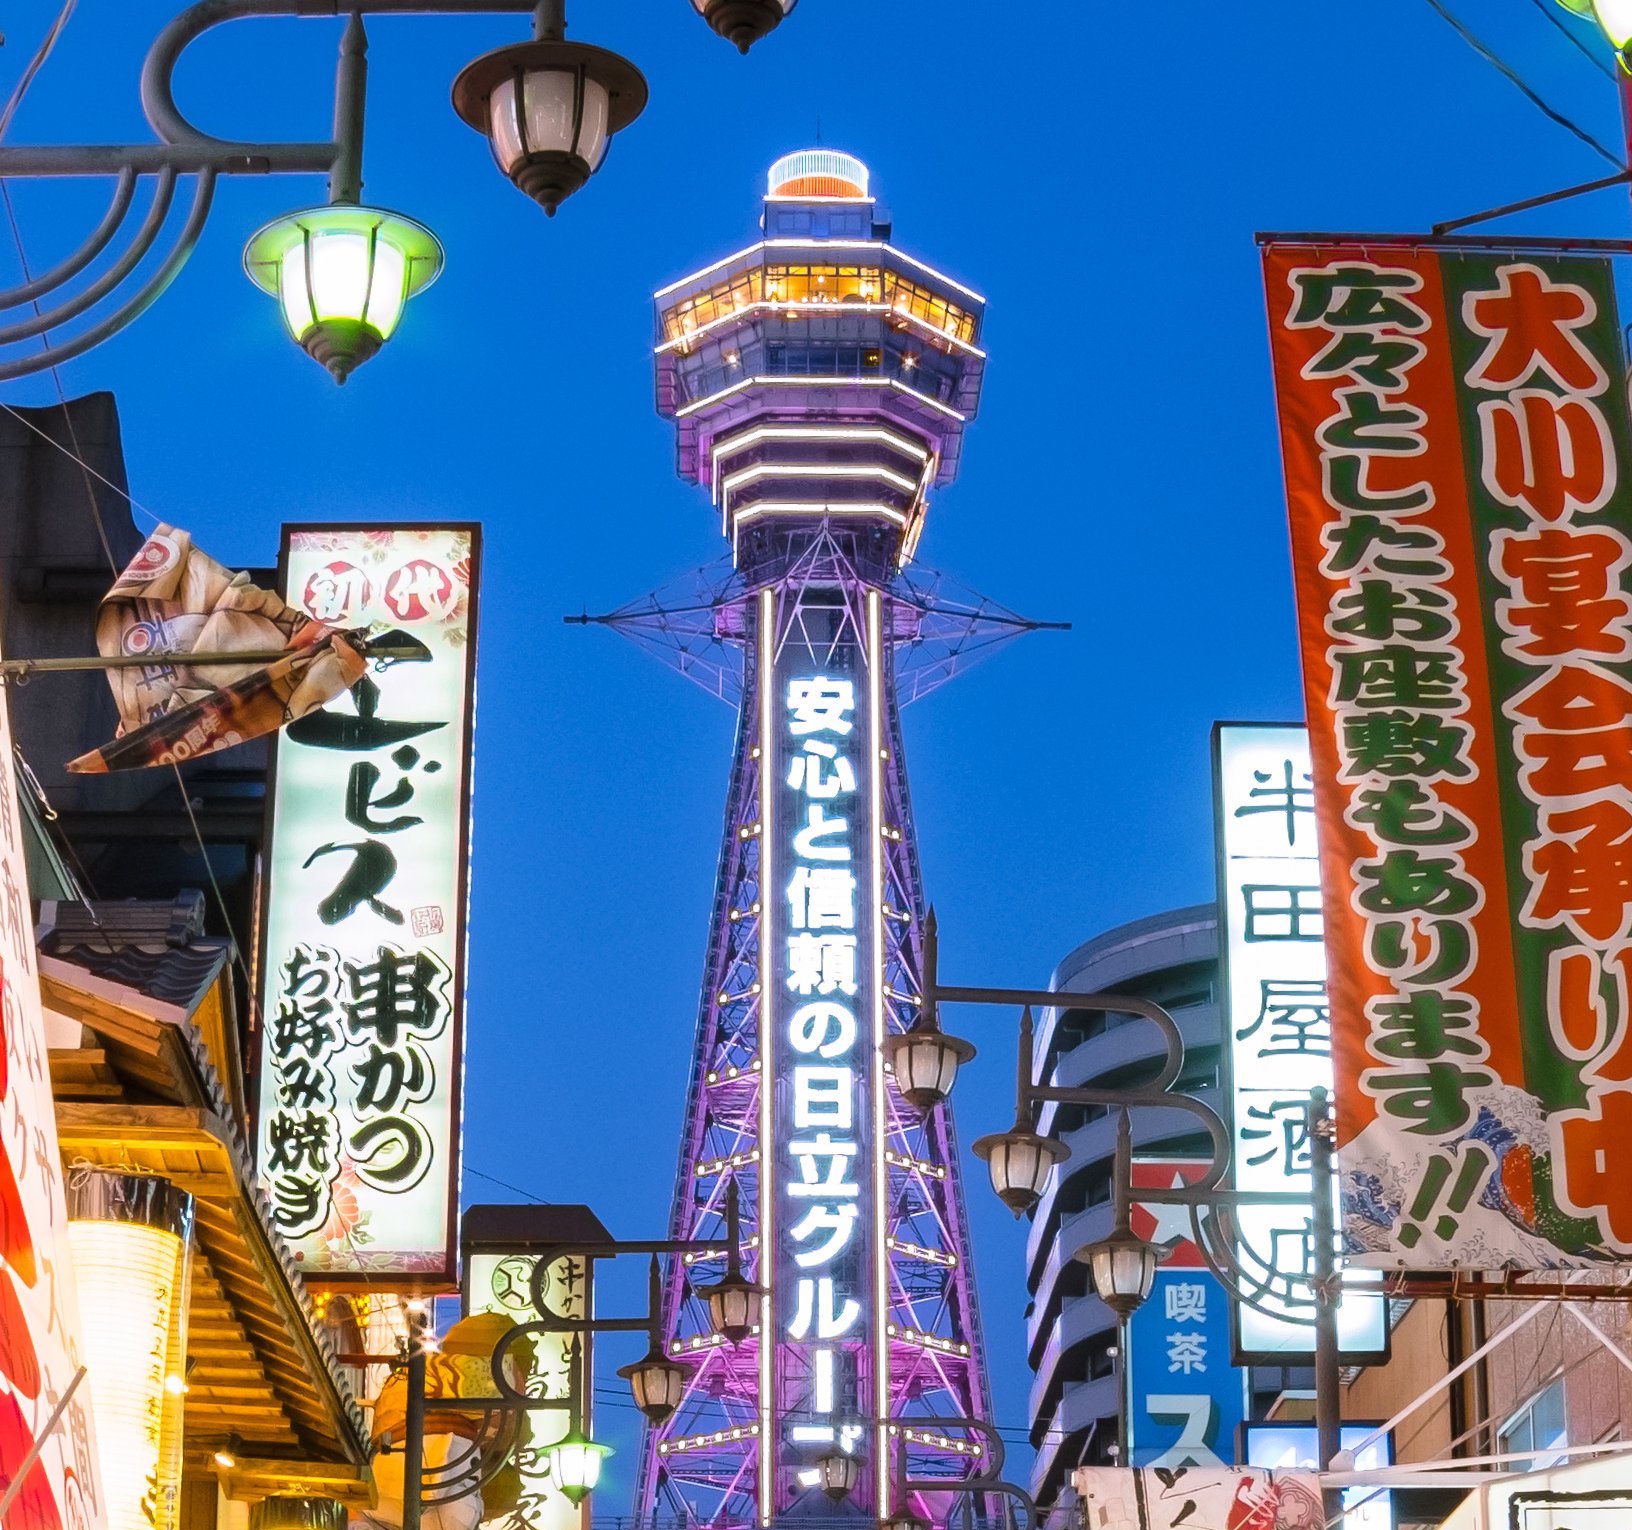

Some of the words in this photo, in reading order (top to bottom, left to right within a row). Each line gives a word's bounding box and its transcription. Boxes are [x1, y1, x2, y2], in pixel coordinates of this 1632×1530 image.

[268, 946, 336, 1228] お好み焼き
[344, 950, 444, 1190] 串かつ
[786, 675, 862, 1488] 安心と信頼の日立グループ
[1165, 1282, 1209, 1374] 喫茶
